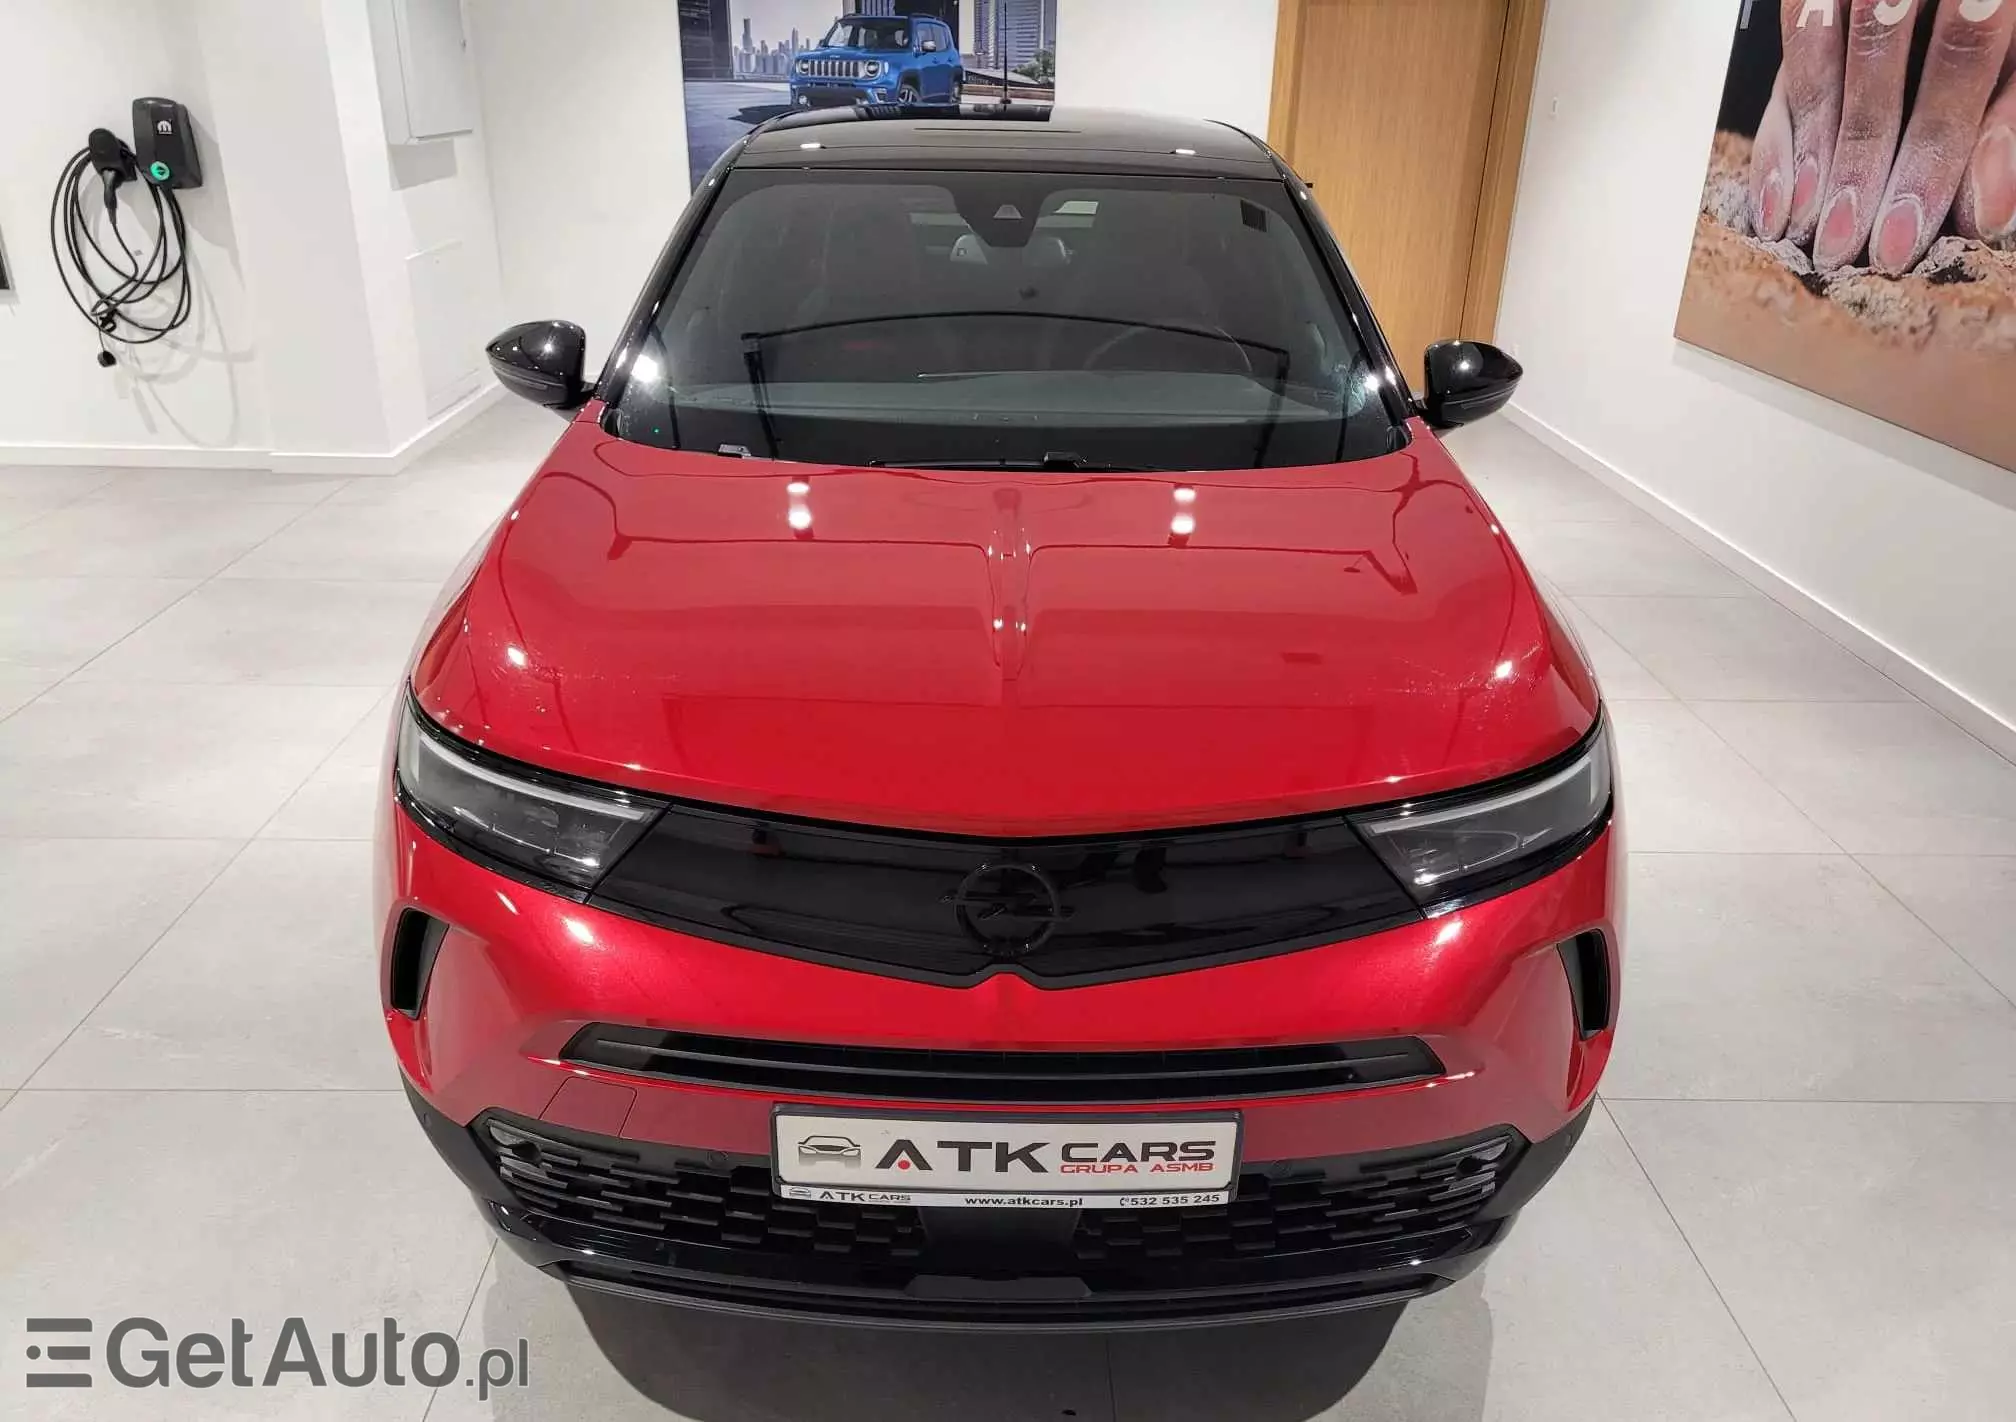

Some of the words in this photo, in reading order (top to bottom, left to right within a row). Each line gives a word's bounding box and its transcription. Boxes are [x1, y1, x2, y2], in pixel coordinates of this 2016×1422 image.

[875, 1139, 1049, 1173] ATK
[1061, 1140, 1217, 1163] CARS
[1060, 1163, 1138, 1174] GRUPA
[1151, 1162, 1215, 1173] ASMB
[820, 1190, 865, 1202] ATK
[868, 1192, 912, 1201] CARS
[964, 1196, 1083, 1207] www.atkcars.pl
[1130, 1196, 1158, 1206] 532
[1162, 1195, 1189, 1205] 535
[1193, 1193, 1220, 1204] 245
